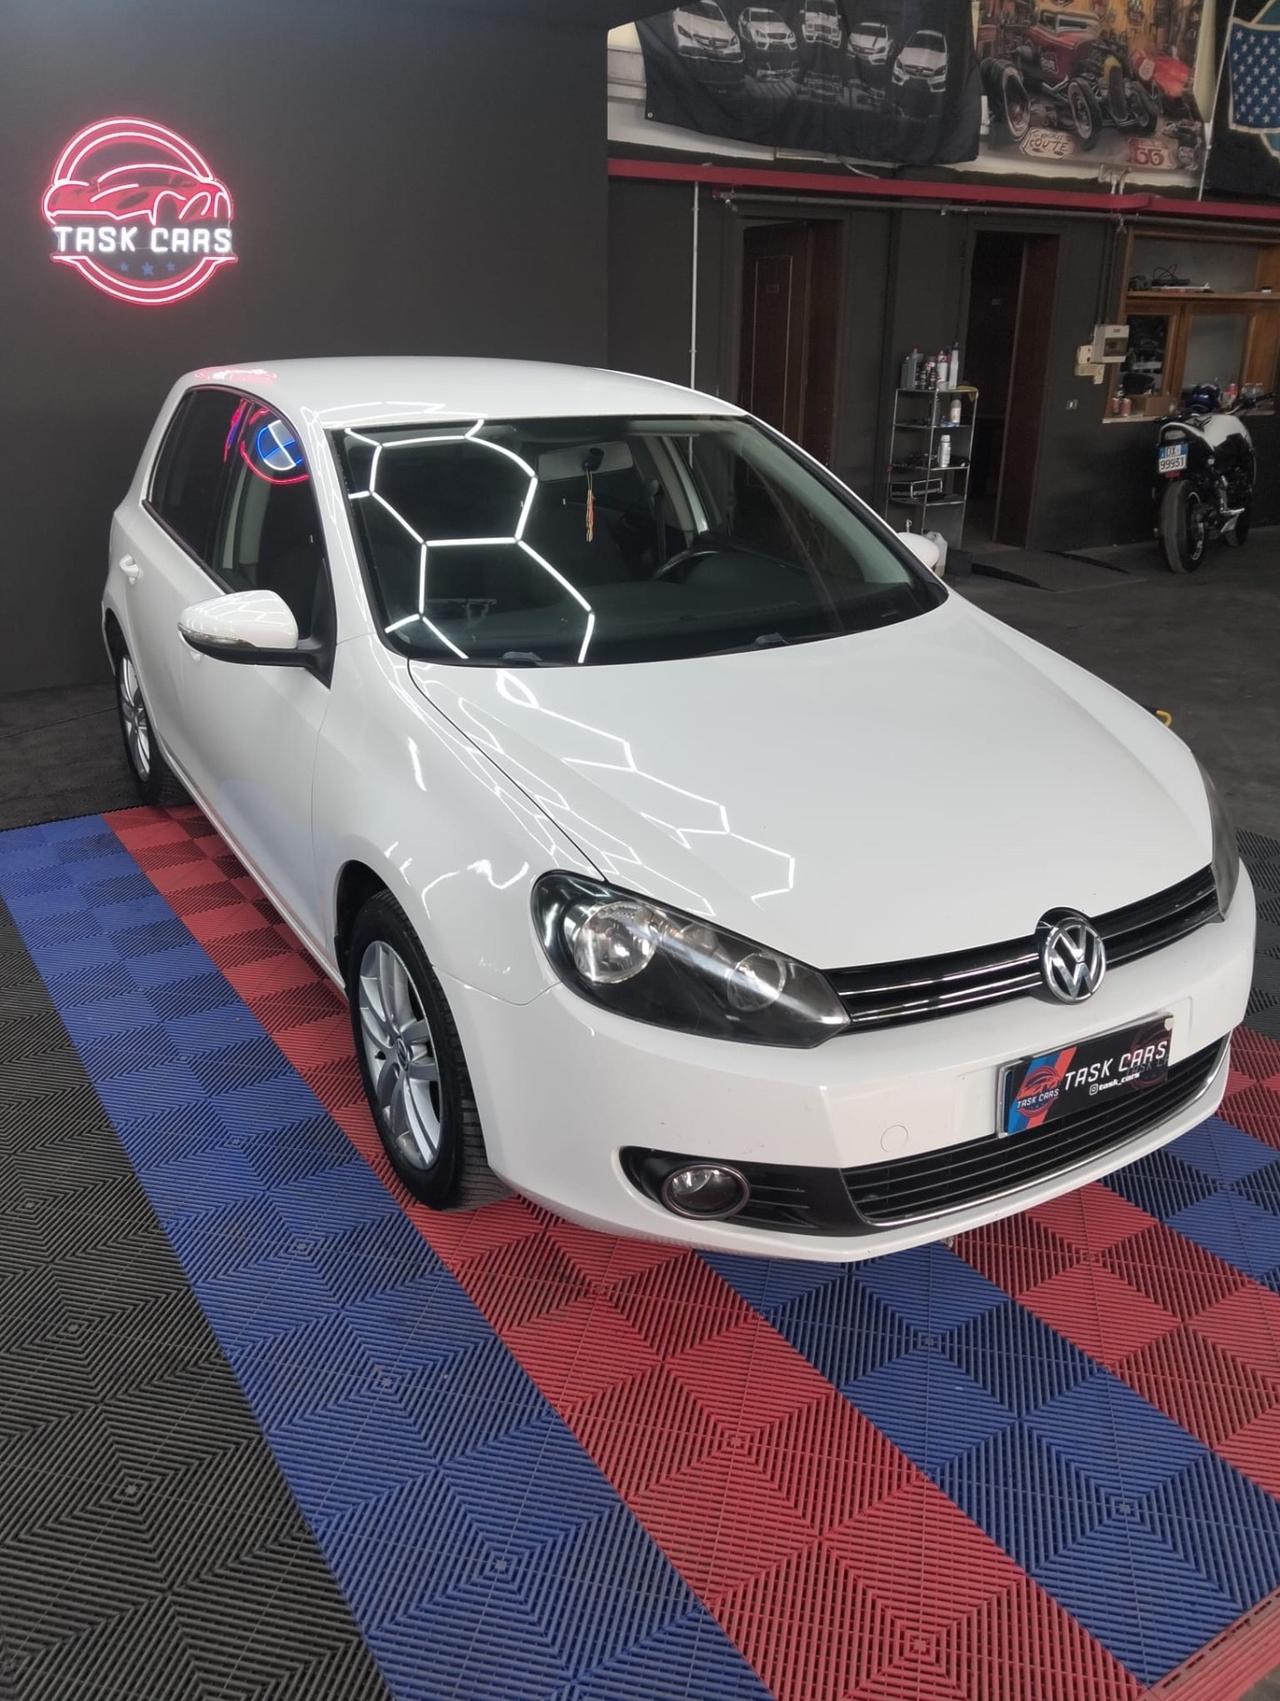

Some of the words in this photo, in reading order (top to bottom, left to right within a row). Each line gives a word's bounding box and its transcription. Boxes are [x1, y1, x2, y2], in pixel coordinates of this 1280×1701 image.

[53, 226, 138, 252] TASK
[150, 227, 232, 253] CARS
[1047, 922, 1101, 1000] VW
[1065, 1058, 1114, 1091] TASK
[1118, 1041, 1168, 1072] CARS
[1017, 1095, 1038, 1109] TASK
[1038, 1088, 1060, 1103] CARS
